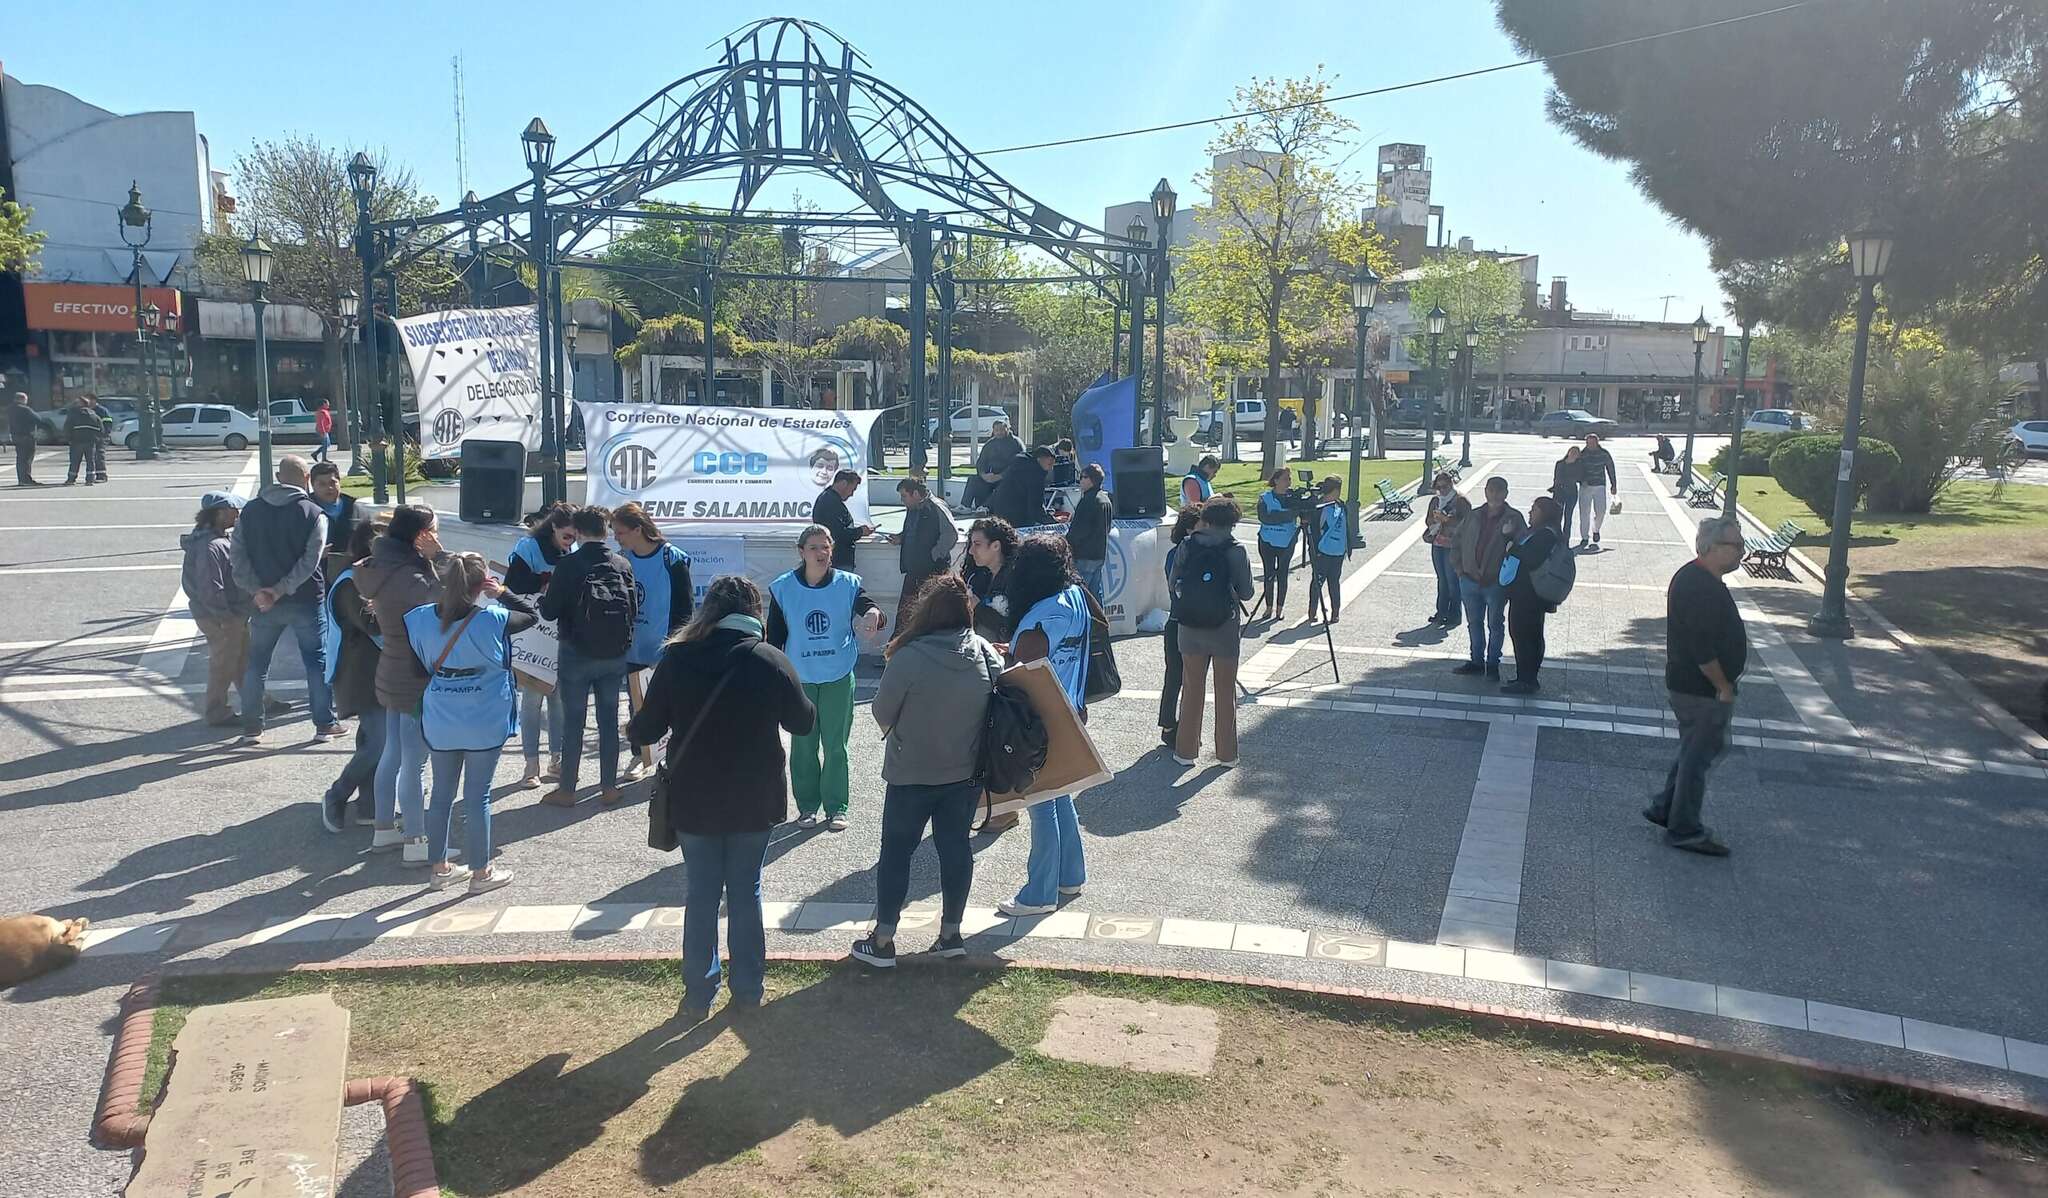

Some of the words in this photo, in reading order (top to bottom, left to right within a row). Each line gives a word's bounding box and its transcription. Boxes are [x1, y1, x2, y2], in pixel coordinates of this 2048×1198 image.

[53, 302, 129, 315] EFECTIVO
[404, 315, 482, 348] SUBSECRETARIA
[467, 378, 531, 401] DELEGACION
[434, 410, 461, 443] ATE
[605, 410, 680, 424] Corriente
[685, 413, 754, 427] Nacional
[758, 417, 778, 428] de
[782, 417, 852, 429] Estatales
[610, 444, 657, 491] ATE
[693, 451, 768, 475] CCC
[692, 501, 812, 518] SALAMANC
[807, 612, 828, 634] ATE
[801, 650, 811, 658] LA
[444, 686, 482, 694] PAMPA
